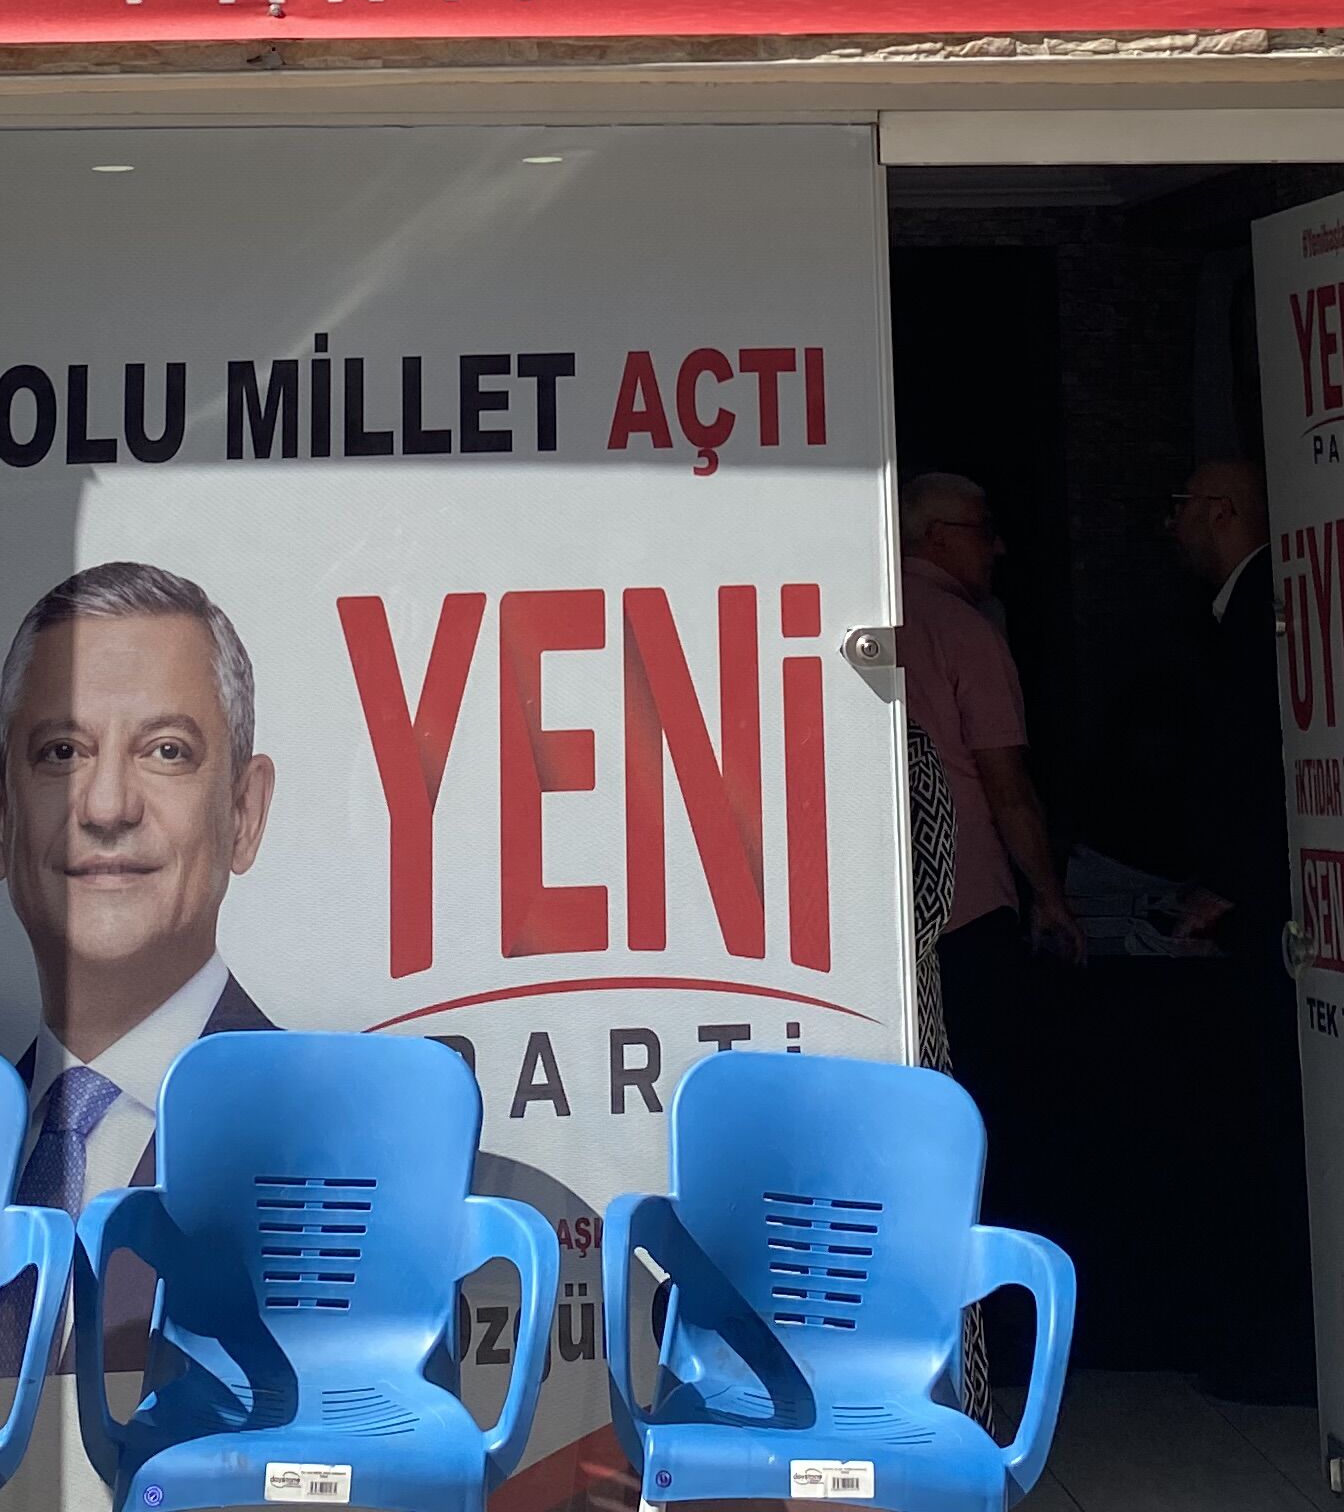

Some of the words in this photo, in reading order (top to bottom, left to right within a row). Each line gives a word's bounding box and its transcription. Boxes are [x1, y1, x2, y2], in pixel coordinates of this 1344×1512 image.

[225, 332, 576, 461] MİLLET
[606, 346, 829, 477] AÇTI
[1306, 996, 1338, 1038] TEK
